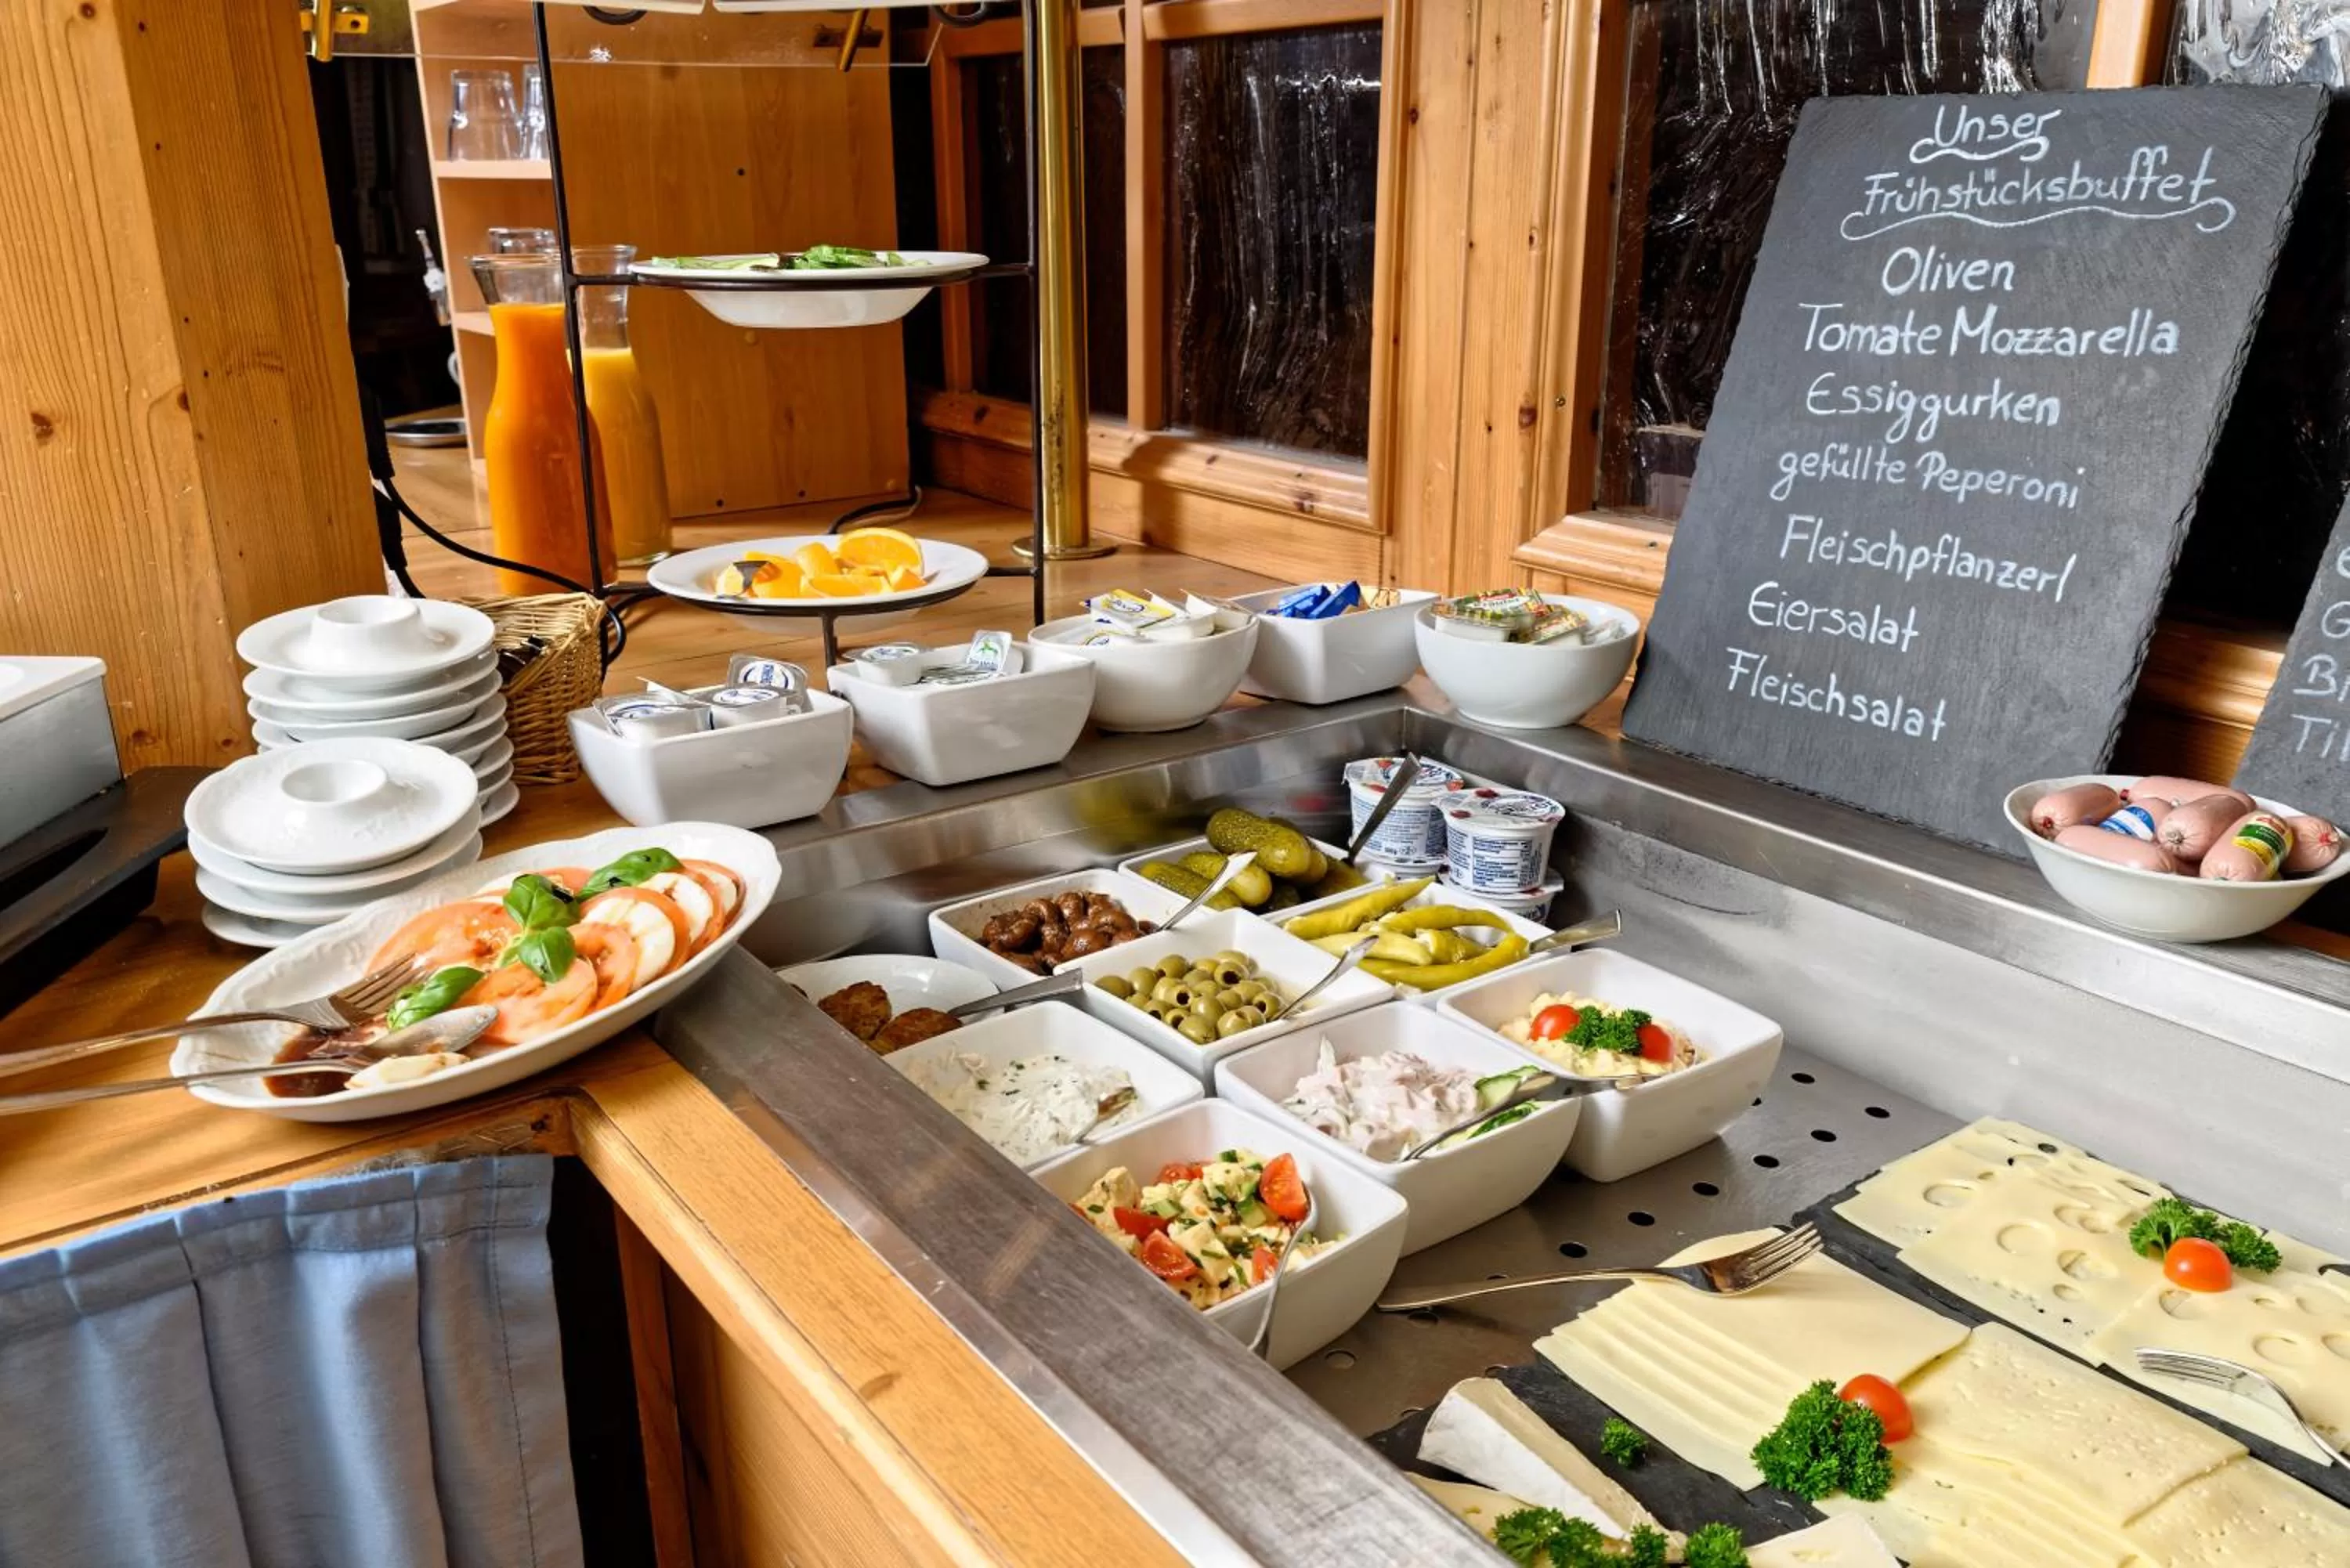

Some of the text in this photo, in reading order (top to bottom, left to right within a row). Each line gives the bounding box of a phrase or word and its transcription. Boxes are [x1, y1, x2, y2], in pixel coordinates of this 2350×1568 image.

[1934, 104, 2062, 144] Unser
[1864, 146, 2217, 216] Frühstücksbuffet
[1882, 246, 2016, 295] Oliven
[1799, 302, 2180, 356] Tomate Mozzarella
[1806, 372, 2060, 443] Essiggurken
[1770, 443, 2086, 508] gefüllte Peperoni
[1780, 515, 2077, 602] Fleischpflanzerl
[1748, 582, 1919, 652] Eiersalat
[1726, 647, 1947, 742] Fleischsalat
